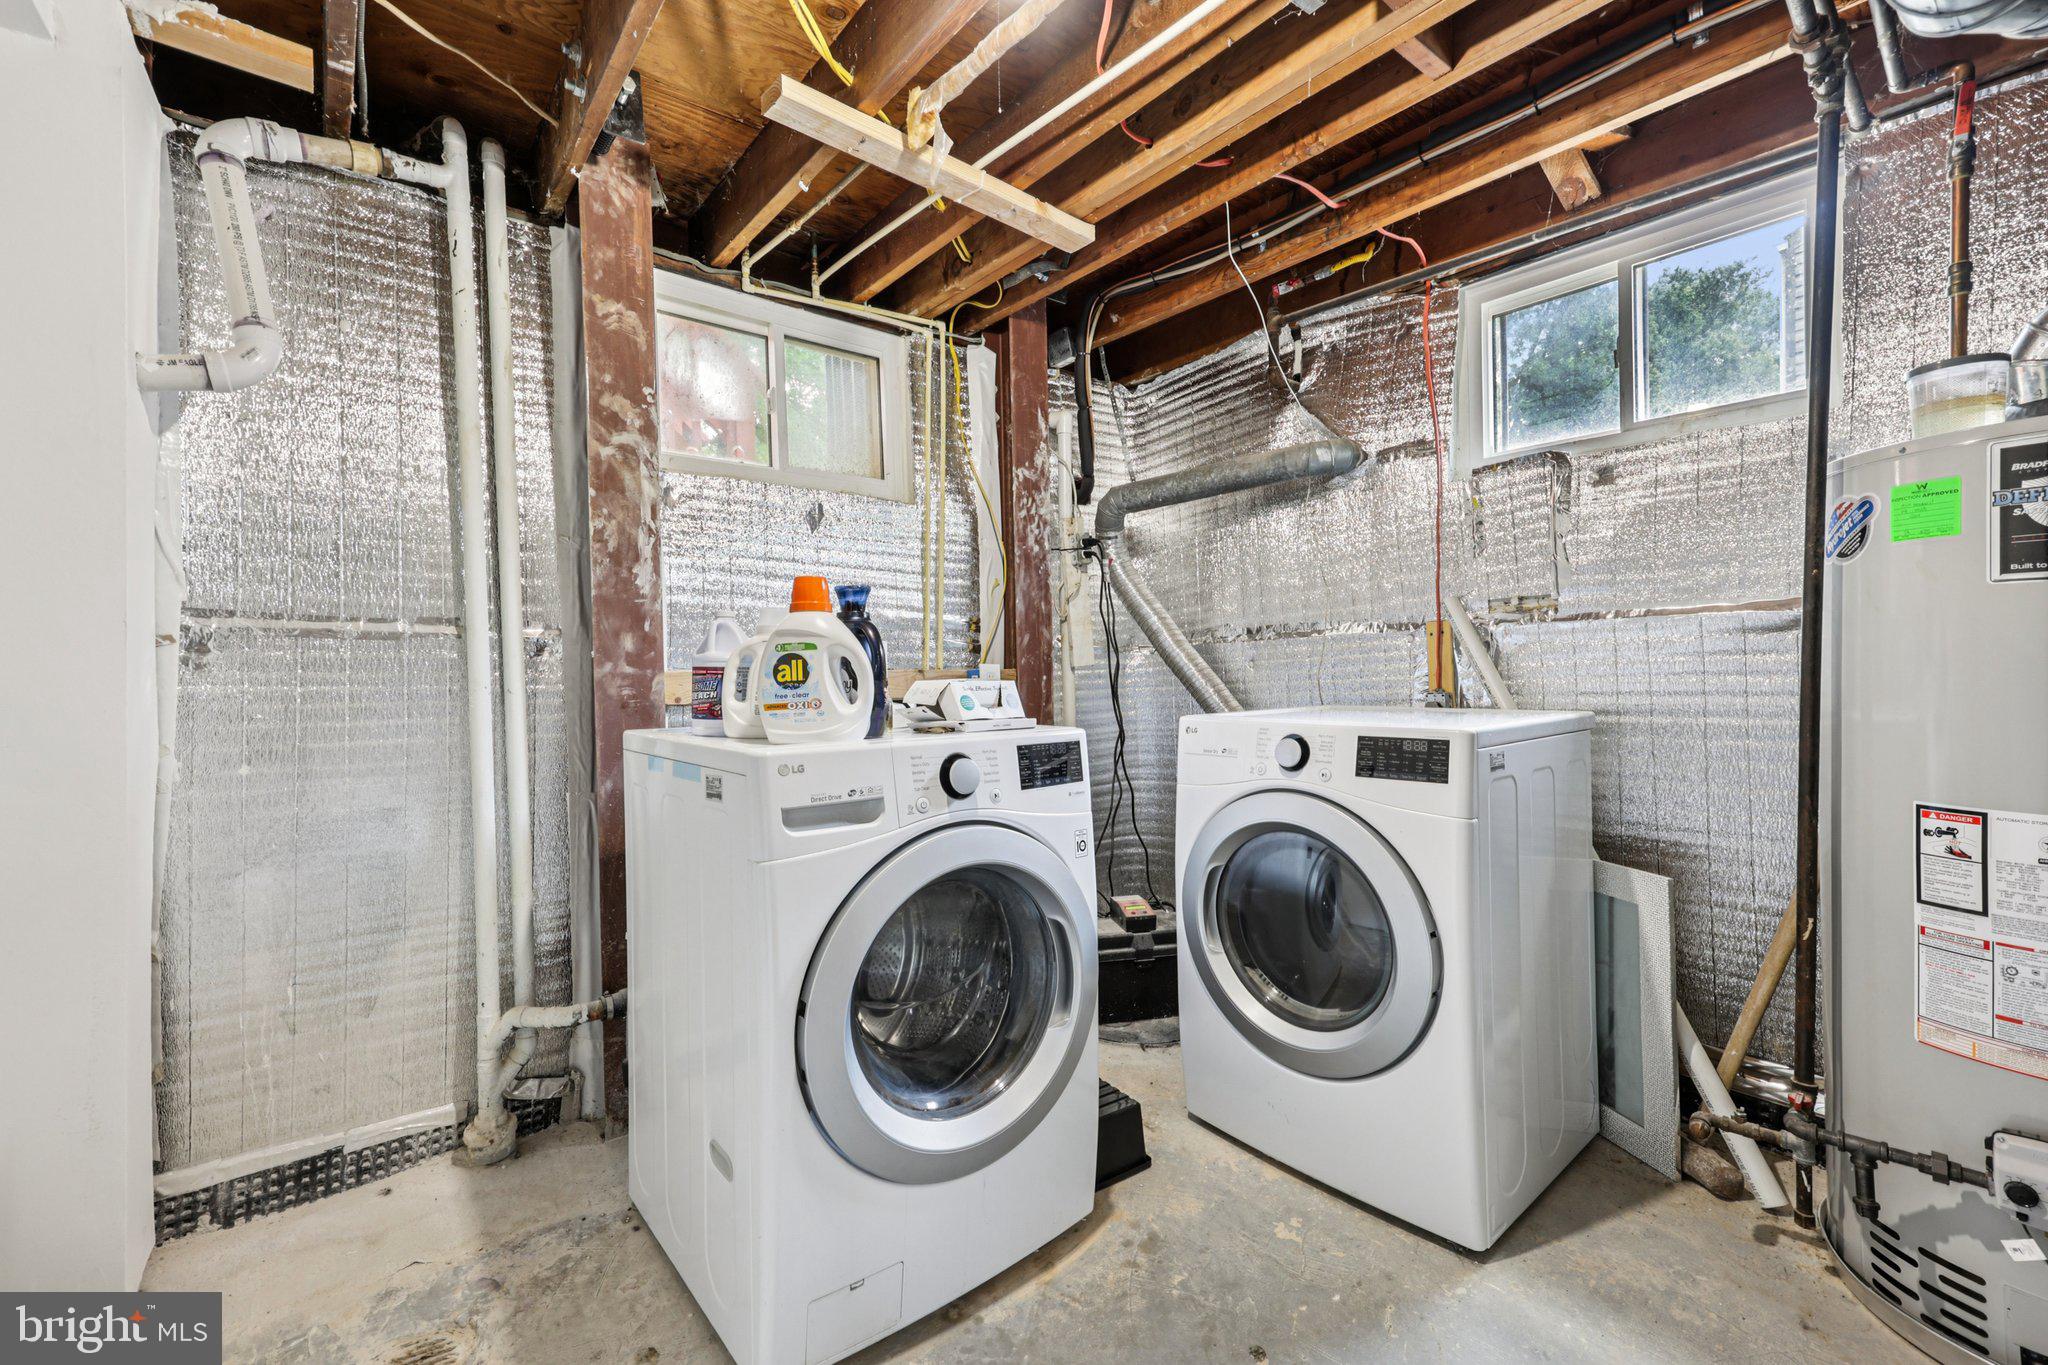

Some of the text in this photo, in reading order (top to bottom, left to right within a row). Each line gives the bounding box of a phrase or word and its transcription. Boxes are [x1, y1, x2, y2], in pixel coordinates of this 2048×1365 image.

[1922, 488, 1960, 498] APPROVED
[776, 659, 804, 683] all
[791, 764, 806, 774] LG
[810, 795, 828, 803] Direct
[1940, 813, 1973, 823] DANGER
[1995, 816, 2030, 826] AUTOMATIC
